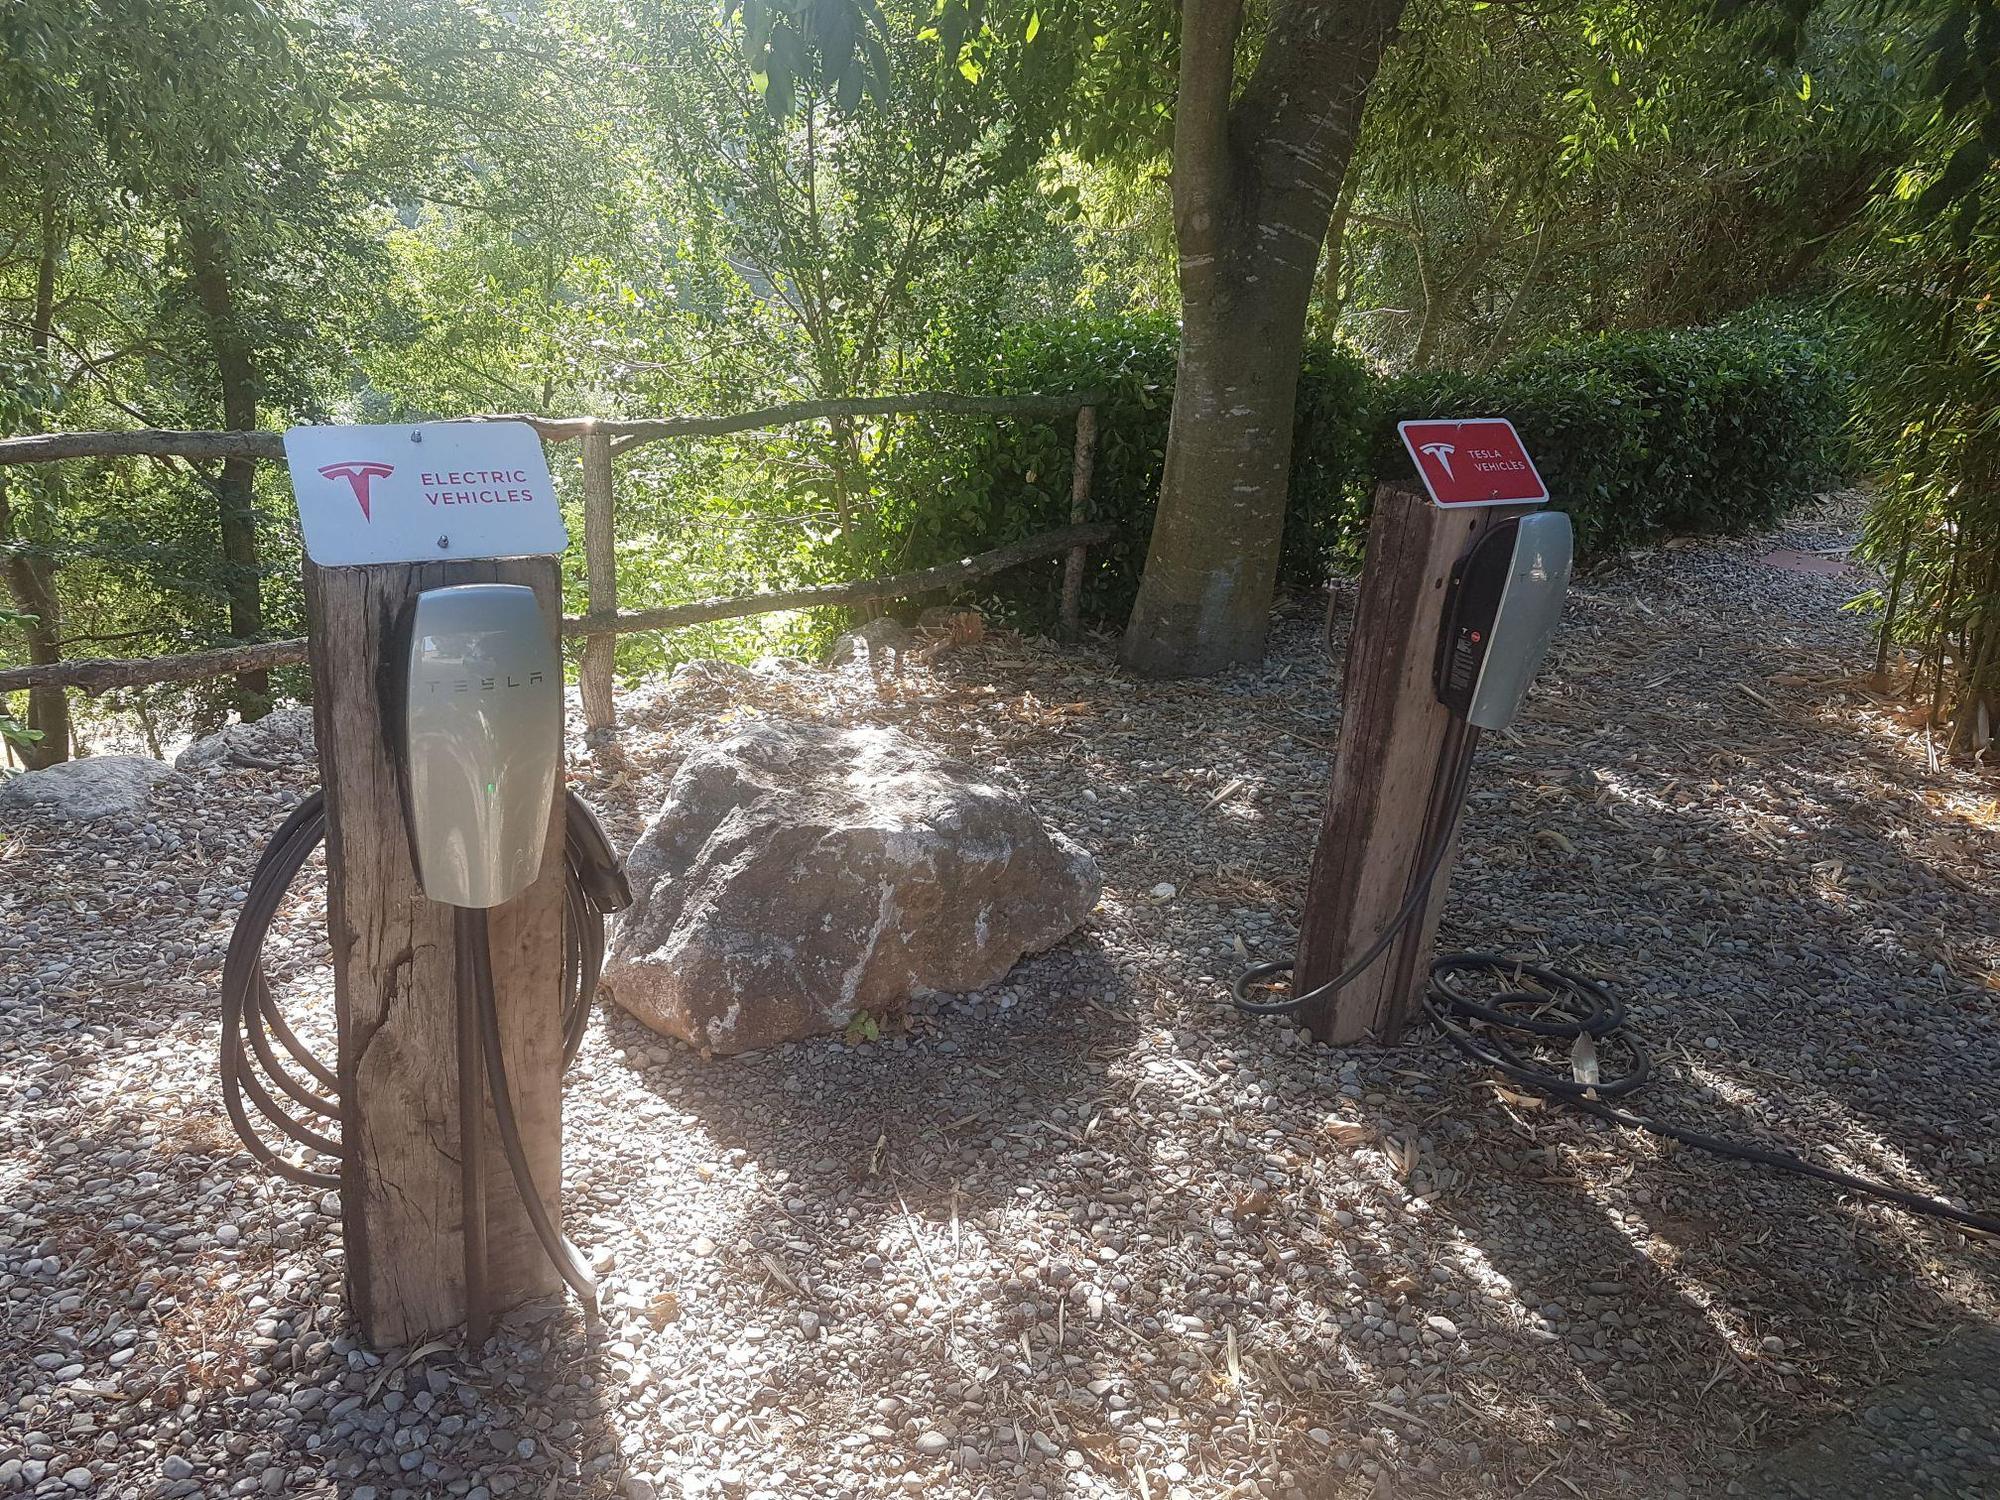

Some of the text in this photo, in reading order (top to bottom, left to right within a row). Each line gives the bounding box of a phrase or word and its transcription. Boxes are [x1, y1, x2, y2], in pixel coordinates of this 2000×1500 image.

[1467, 449, 1502, 459] TESLA
[1474, 461, 1526, 472] VEHICLES
[421, 470, 527, 486] ELECTRIC
[425, 489, 533, 506] VEHICLES
[425, 671, 543, 693] TESLA
